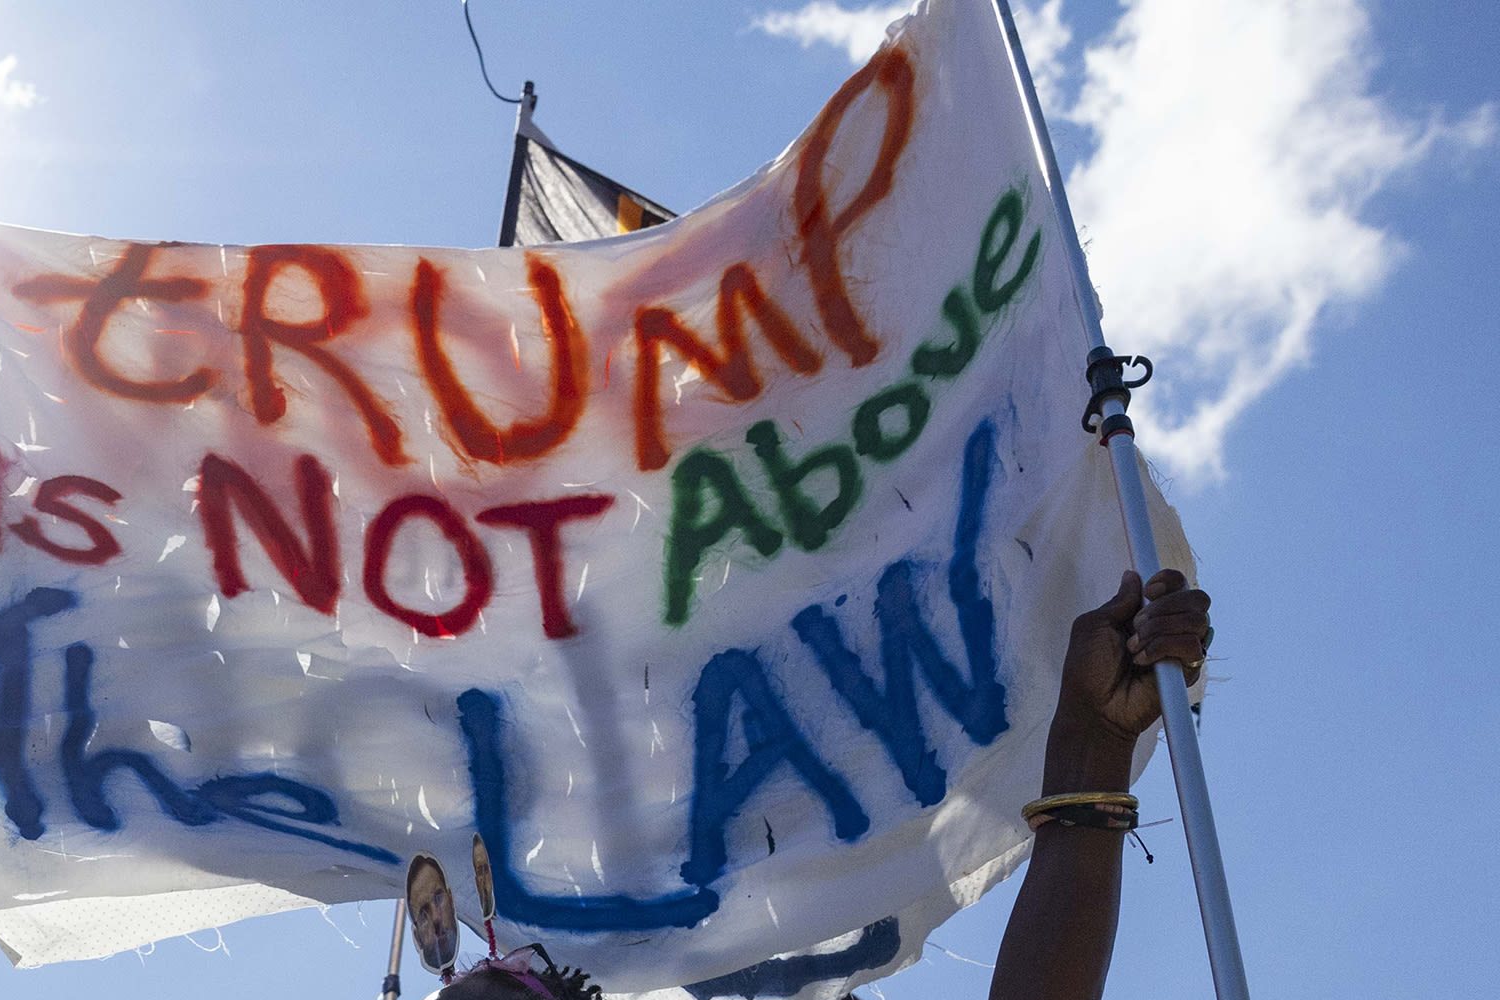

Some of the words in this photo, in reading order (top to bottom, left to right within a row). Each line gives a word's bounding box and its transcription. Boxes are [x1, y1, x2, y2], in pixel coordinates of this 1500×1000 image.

[197, 452, 615, 640] NOT
[663, 188, 1042, 626] Above
[455, 414, 1010, 931] LAW
